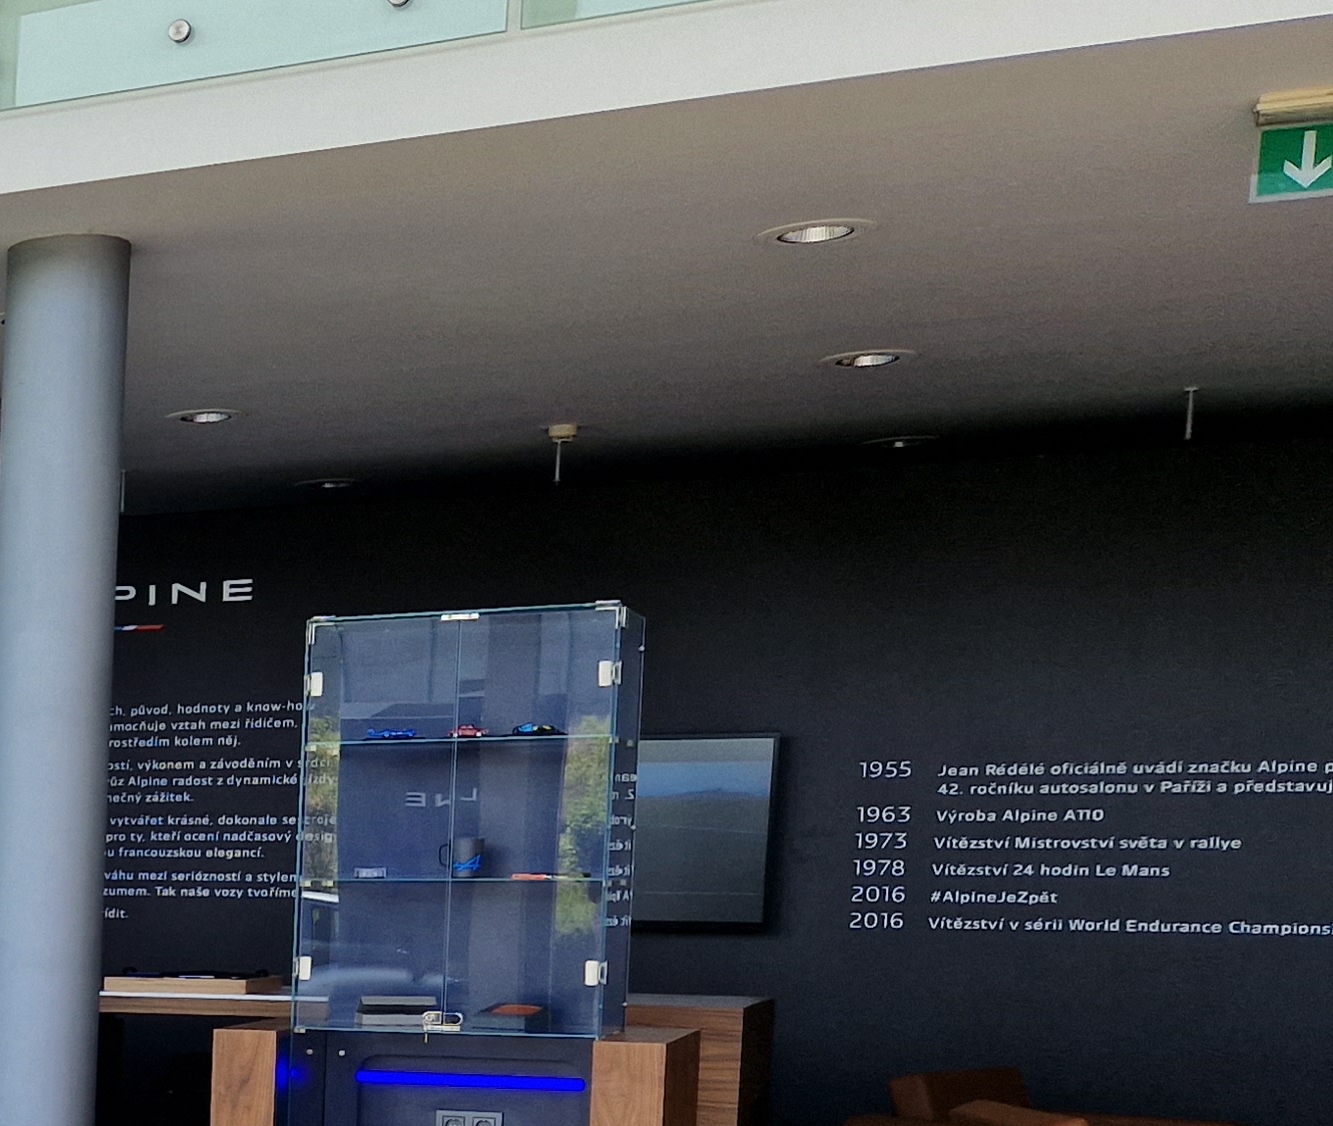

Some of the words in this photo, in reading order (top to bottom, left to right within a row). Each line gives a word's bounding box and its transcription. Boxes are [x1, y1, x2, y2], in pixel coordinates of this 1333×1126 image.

[114, 578, 254, 606] PINE
[130, 704, 172, 717] původ,
[176, 702, 230, 717] hodnoty
[234, 703, 243, 713] a
[170, 718, 206, 731] vztah
[210, 718, 241, 731] mezi
[108, 735, 170, 748] rostředím
[174, 735, 213, 747] kolem
[217, 734, 241, 748] něj.
[137, 758, 195, 773] výkonem
[199, 759, 207, 770] a
[210, 756, 281, 770] závoděním
[285, 759, 293, 769] v
[859, 761, 913, 778] 1955
[937, 764, 980, 777] Jean
[985, 762, 1045, 777] Rédélé
[1050, 761, 1128, 776] oficiálně
[1132, 759, 1184, 775] uvádí
[1187, 759, 1252, 774] značku
[1256, 759, 1318, 775] Alpine
[127, 774, 168, 788] Alpine
[172, 774, 213, 787] radost
[216, 775, 224, 786] z
[226, 773, 298, 788] dynamické
[937, 783, 964, 796] 42.
[969, 781, 1034, 795] ročníku
[1039, 781, 1139, 795] autosalonu
[1143, 783, 1155, 793] v
[1159, 779, 1212, 794] Paříži
[1216, 782, 1228, 793] a
[144, 790, 195, 803] zážitek.
[109, 814, 164, 828] vytvářet
[167, 814, 213, 827] krásné,
[217, 813, 277, 826] dokonale
[856, 805, 911, 823] 1963
[935, 809, 997, 824] Výroba
[1002, 809, 1058, 824] Alpine
[1063, 808, 1105, 822] A110
[105, 832, 126, 844] pro
[130, 831, 146, 844] ty,
[150, 830, 182, 842] kteří
[183, 830, 219, 843] ocení
[222, 828, 292, 844] nadčasový
[854, 832, 908, 850] 1973
[933, 835, 1012, 850] Vítězství
[1014, 835, 1115, 850] Mistrovství
[1119, 835, 1168, 850] světa
[1173, 839, 1185, 850] v
[1189, 836, 1243, 852] rallye
[118, 846, 202, 859] francouzskou
[205, 847, 265, 861] elegancí.
[138, 871, 168, 882] mezi
[171, 870, 241, 883] seriózností
[245, 872, 253, 882] a
[852, 859, 905, 877] 1978
[931, 863, 1007, 877] Vítězství
[1012, 863, 1035, 876] 24
[1039, 863, 1090, 877] hodin
[1095, 864, 1117, 877] Le
[1121, 864, 1171, 878] Mans
[102, 886, 151, 897] zumem.
[154, 886, 177, 897] Tak
[180, 885, 209, 898] naše
[214, 887, 244, 899] vozy
[850, 885, 906, 903] 2016
[930, 890, 1058, 906] #AlpineJeZpět
[849, 912, 904, 930] 2016
[927, 916, 1005, 931] Vítězství
[1009, 921, 1020, 931] v
[1023, 918, 1063, 931] sérii
[1068, 918, 1121, 932] World
[1124, 919, 1223, 934] Endurance
[1228, 920, 1333, 937] Champions
